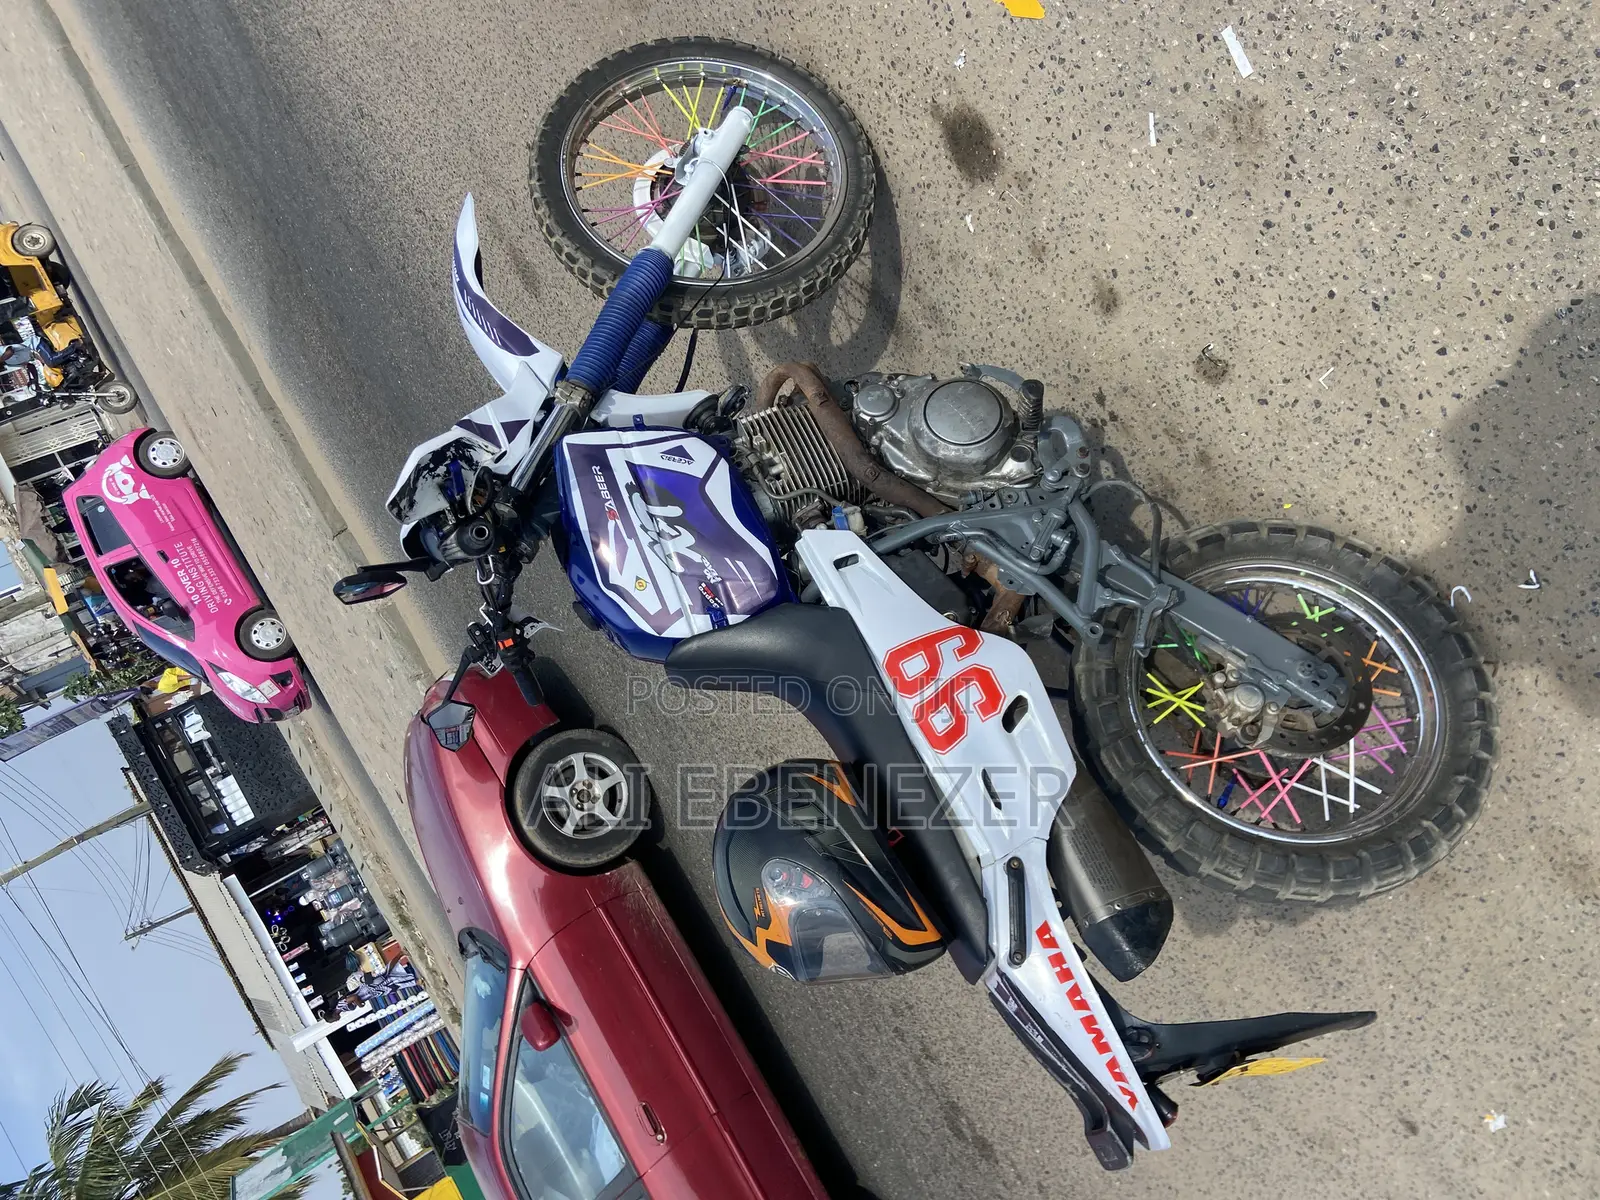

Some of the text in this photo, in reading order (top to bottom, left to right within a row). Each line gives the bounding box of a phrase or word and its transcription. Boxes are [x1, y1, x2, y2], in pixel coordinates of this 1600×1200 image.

[591, 465, 620, 521] SABEER
[171, 558, 202, 604] 10 OVER 10
[173, 541, 219, 613] DRIVING INSTITUTE
[882, 625, 1006, 755] 99
[1035, 920, 1139, 1111] YAMAHA
